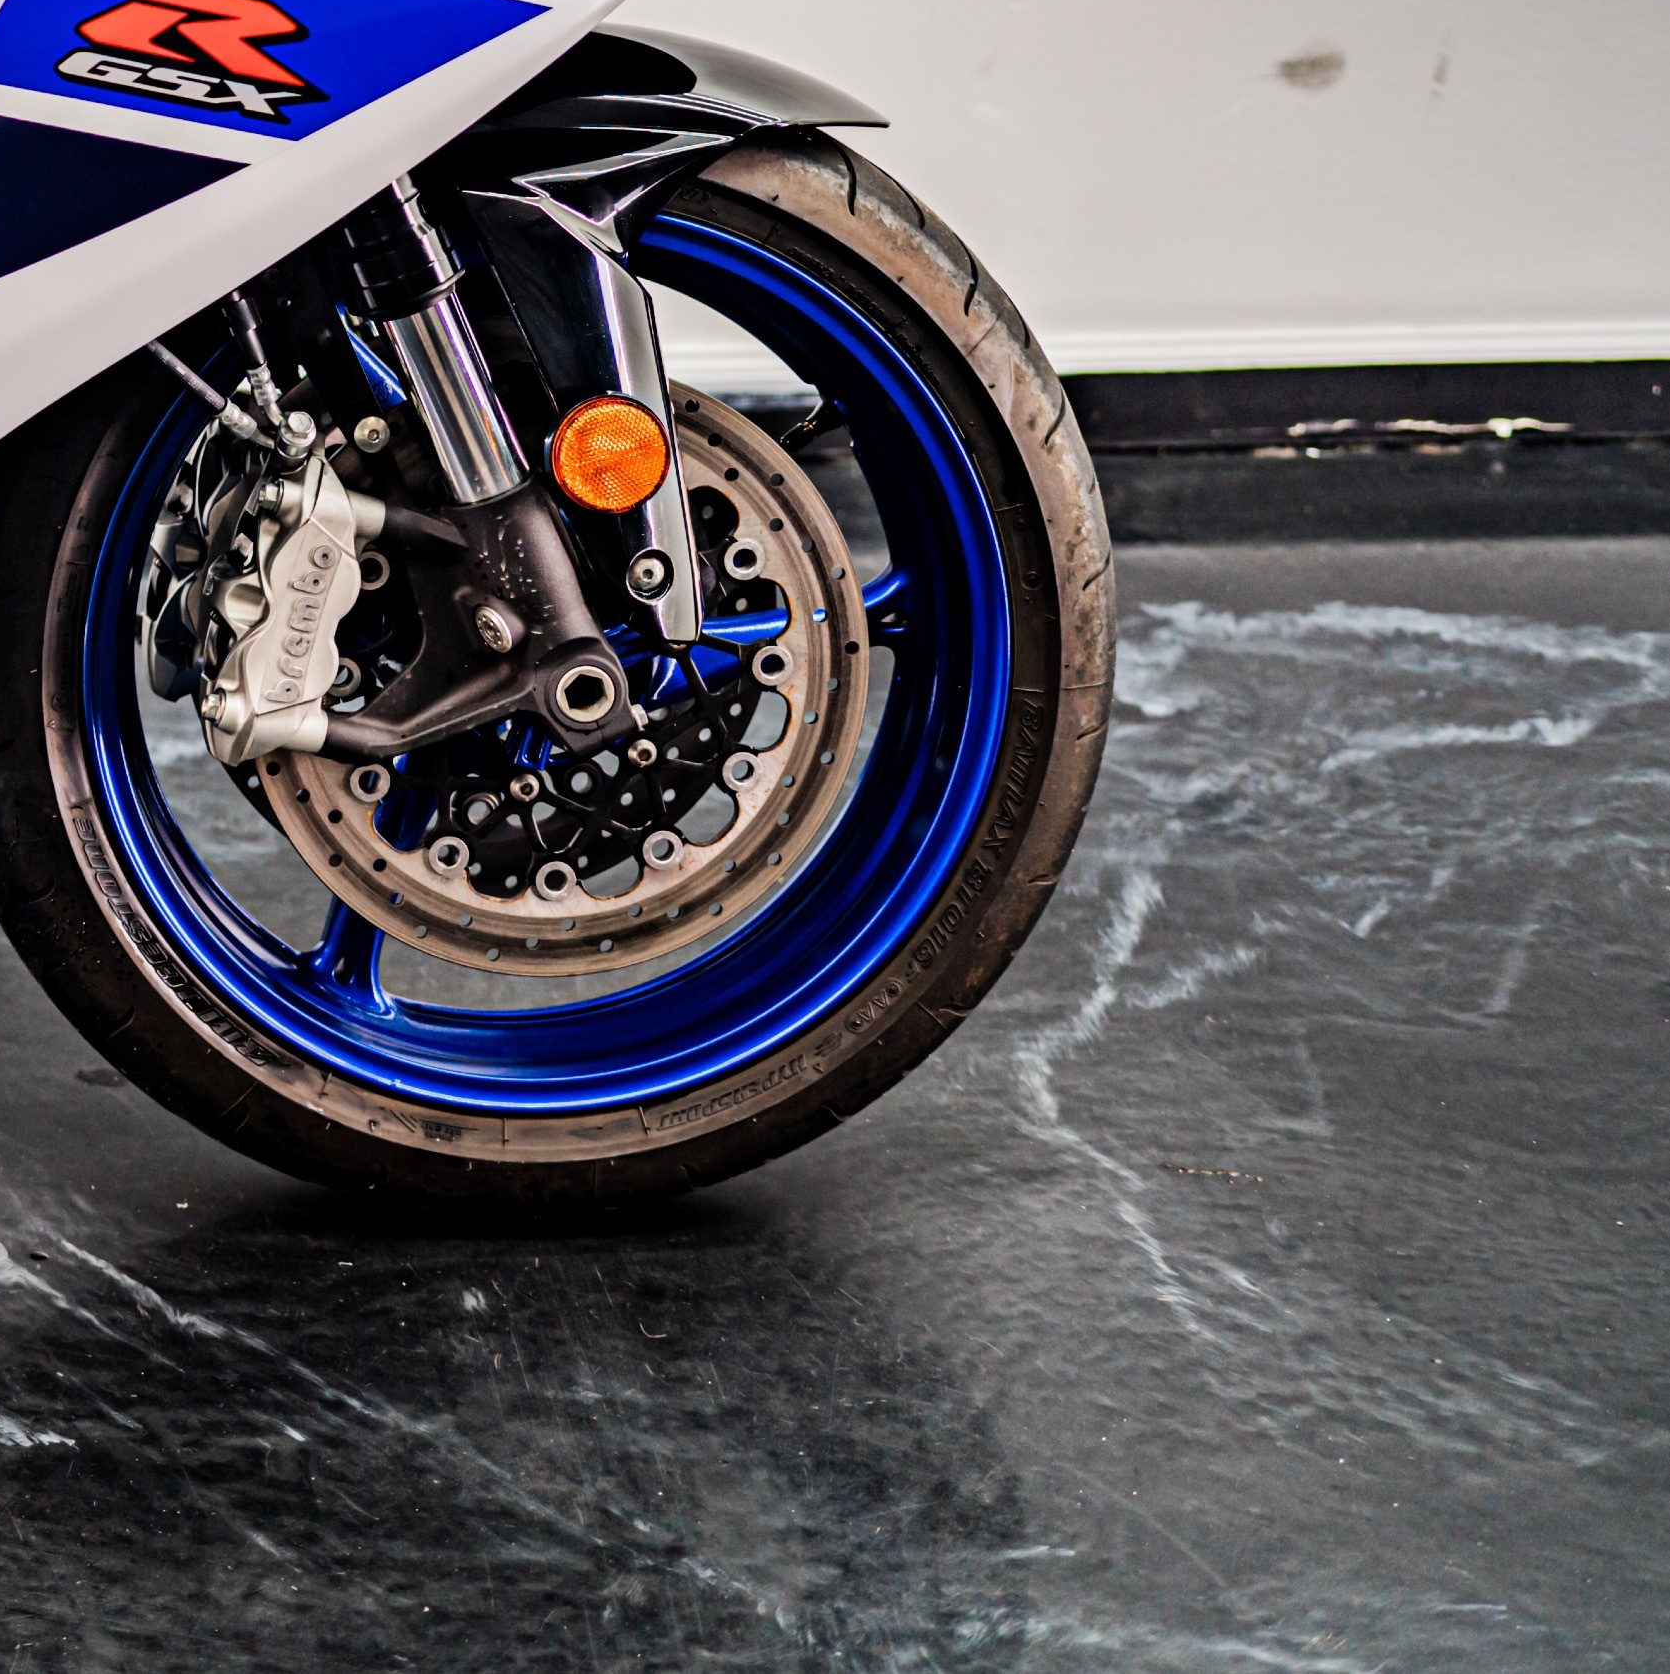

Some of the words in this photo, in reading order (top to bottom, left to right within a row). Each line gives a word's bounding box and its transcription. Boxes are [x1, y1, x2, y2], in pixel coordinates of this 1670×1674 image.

[57, 51, 303, 116] GSX
[266, 544, 336, 703] brembo
[975, 699, 1047, 869] BATTLAX
[69, 810, 281, 1077] BRIDGESTONE
[907, 856, 995, 976] BT016
